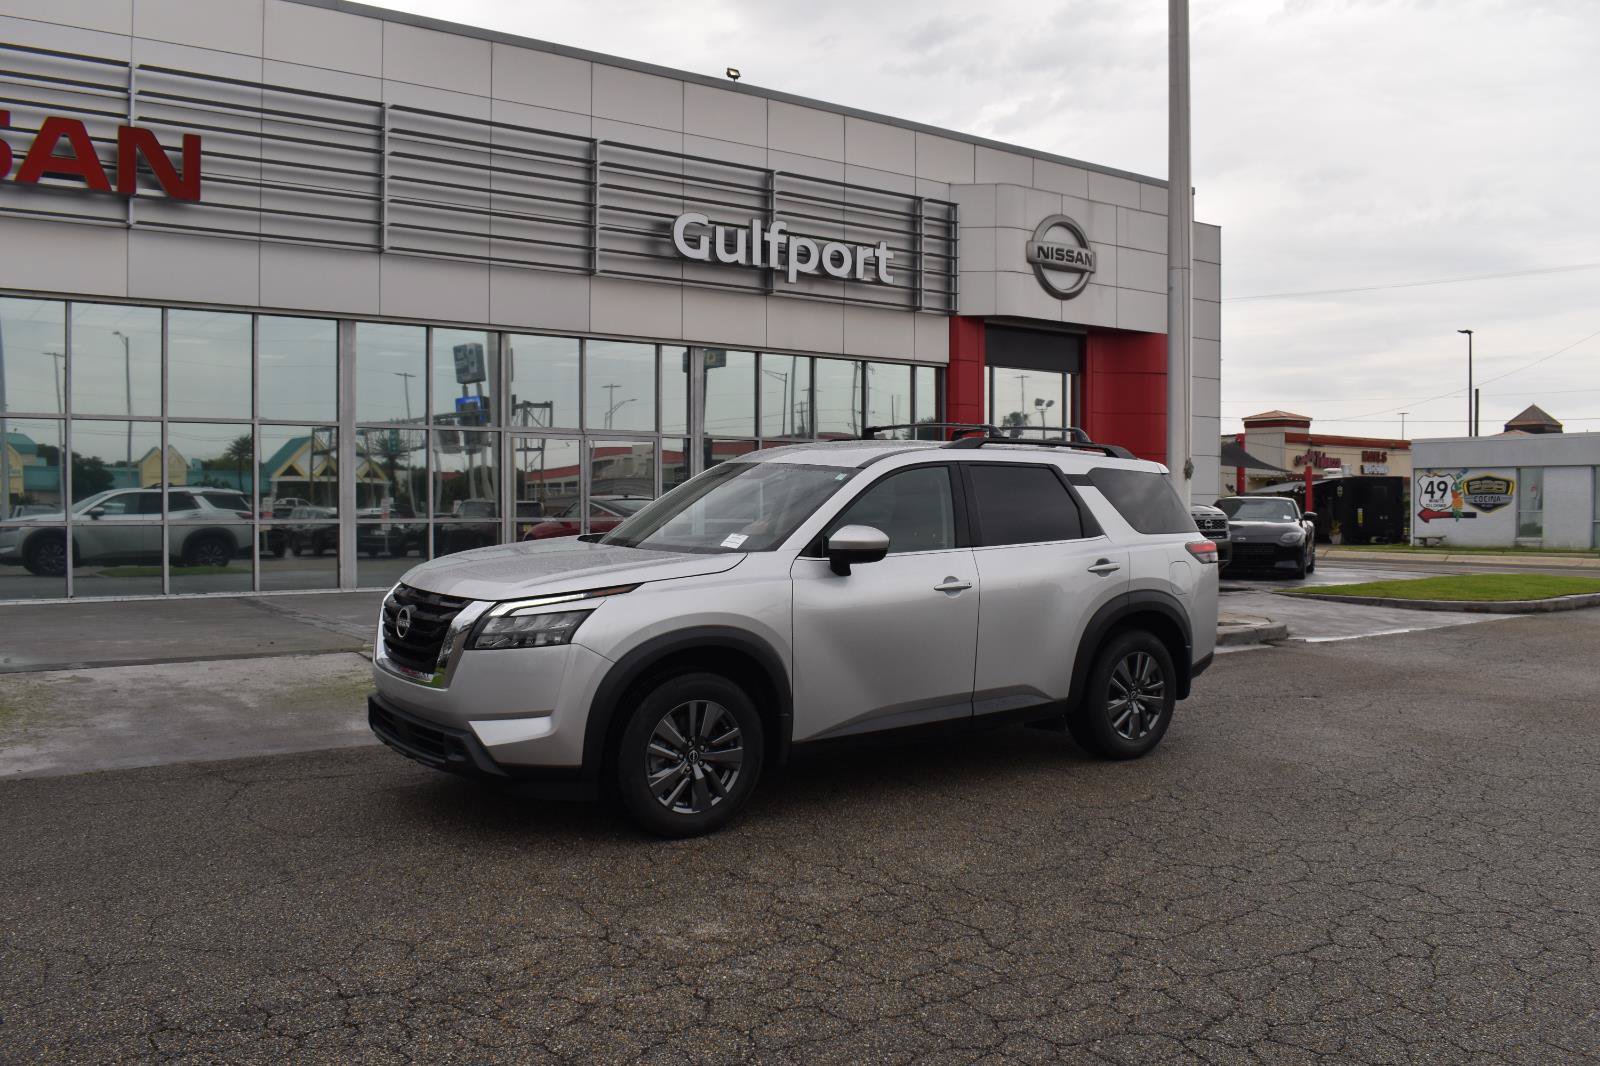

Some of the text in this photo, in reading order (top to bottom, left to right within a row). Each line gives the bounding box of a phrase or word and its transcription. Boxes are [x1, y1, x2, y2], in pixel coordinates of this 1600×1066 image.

[0, 109, 202, 202] AN
[671, 211, 895, 285] Gulfport
[1037, 245, 1093, 267] NISSAN
[1424, 480, 1449, 499] 49
[1473, 495, 1501, 503] COCINA
